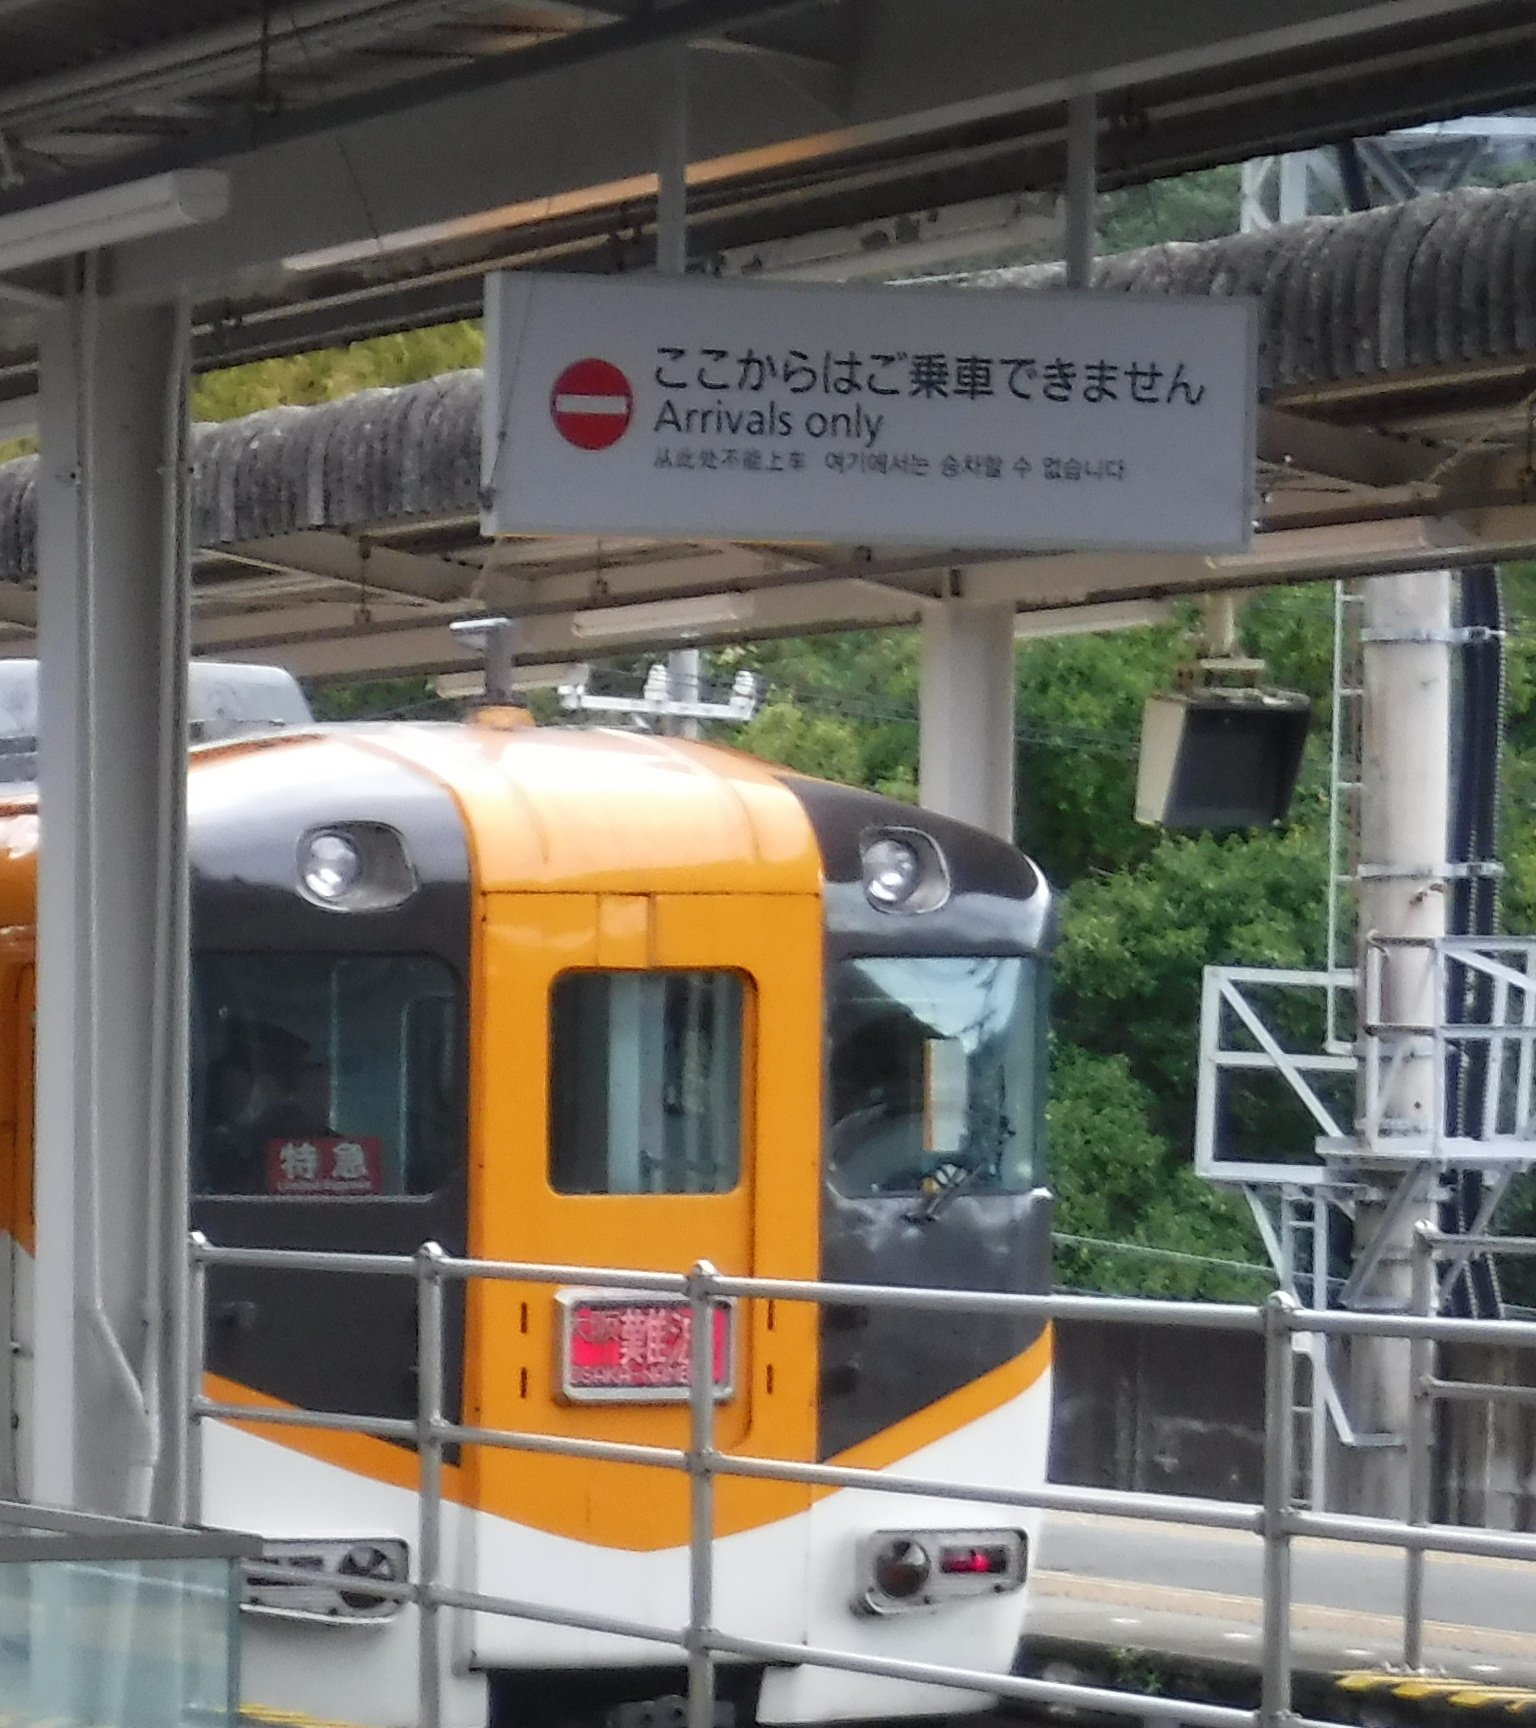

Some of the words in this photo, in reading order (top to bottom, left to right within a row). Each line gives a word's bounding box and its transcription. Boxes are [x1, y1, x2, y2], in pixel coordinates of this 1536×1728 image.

[655, 347, 1205, 405] ここからはご乗車できません
[654, 400, 792, 437] Arrivals
[805, 402, 883, 447] only
[279, 1142, 367, 1179] 特急
